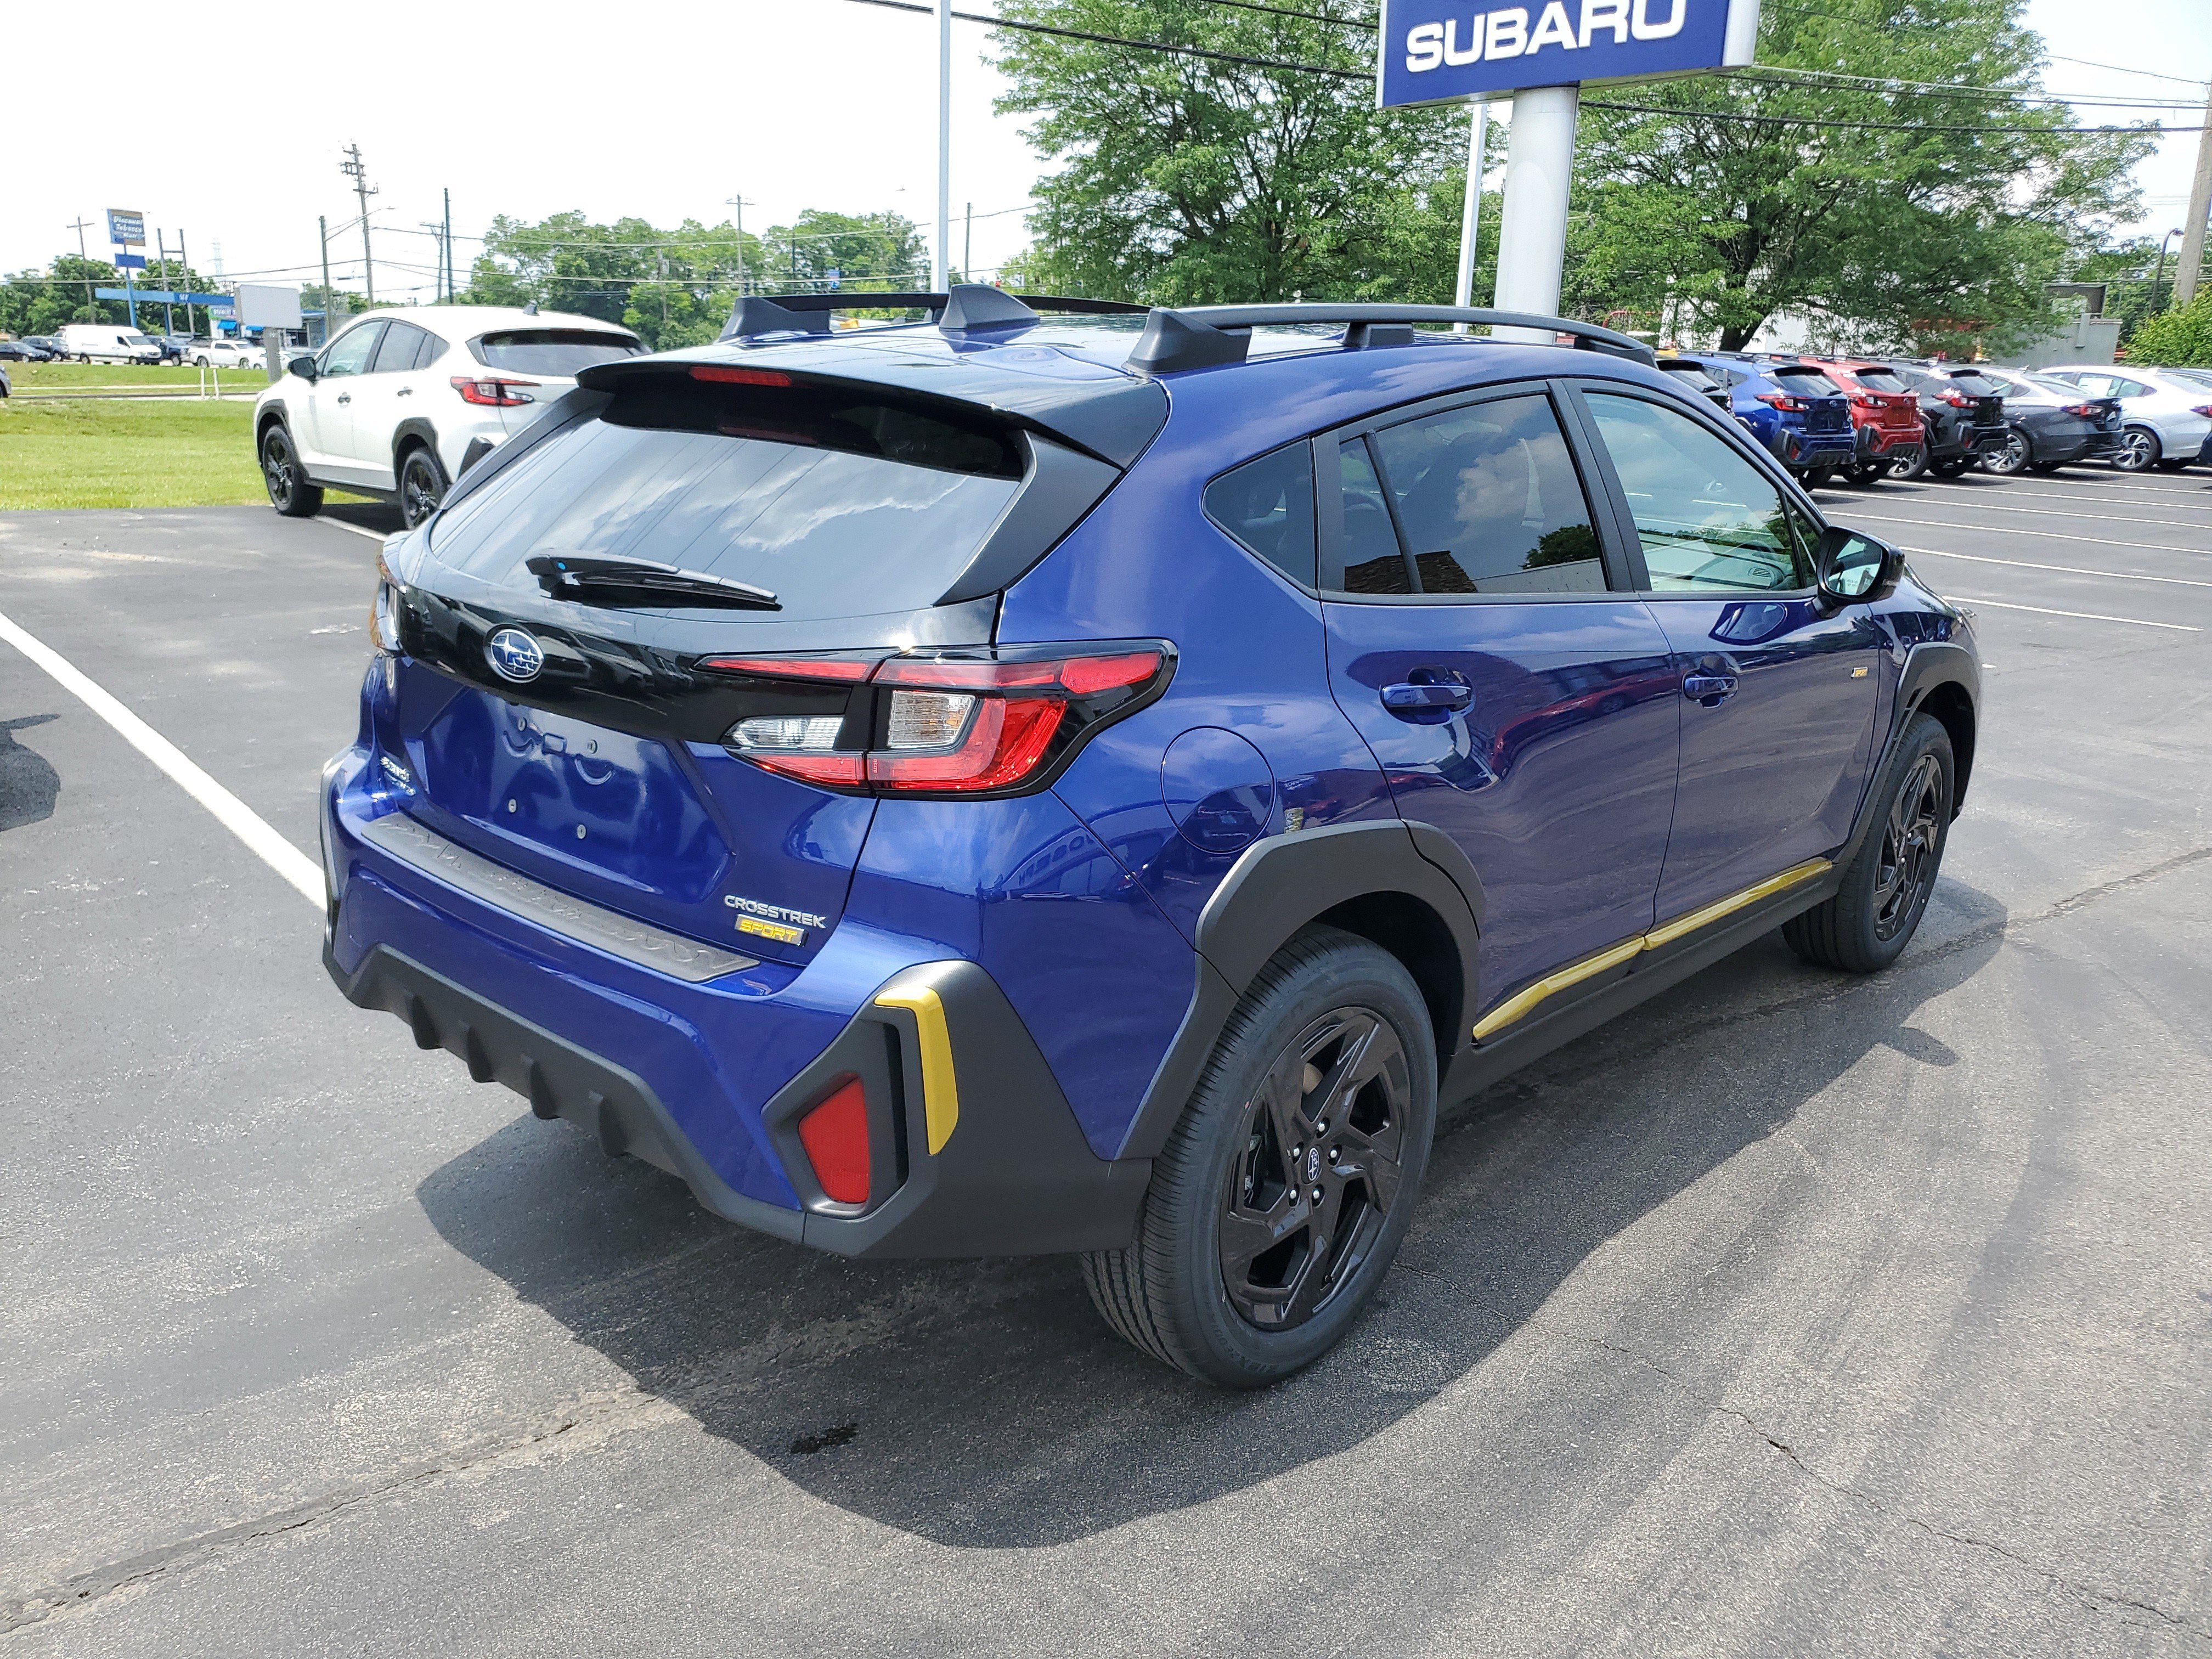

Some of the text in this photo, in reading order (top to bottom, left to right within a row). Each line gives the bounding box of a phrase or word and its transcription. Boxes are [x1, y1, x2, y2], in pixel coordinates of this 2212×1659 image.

[1406, 0, 1687, 72] SUBARU
[724, 895, 826, 928] CROSSTREK
[740, 919, 797, 941] SPORT
